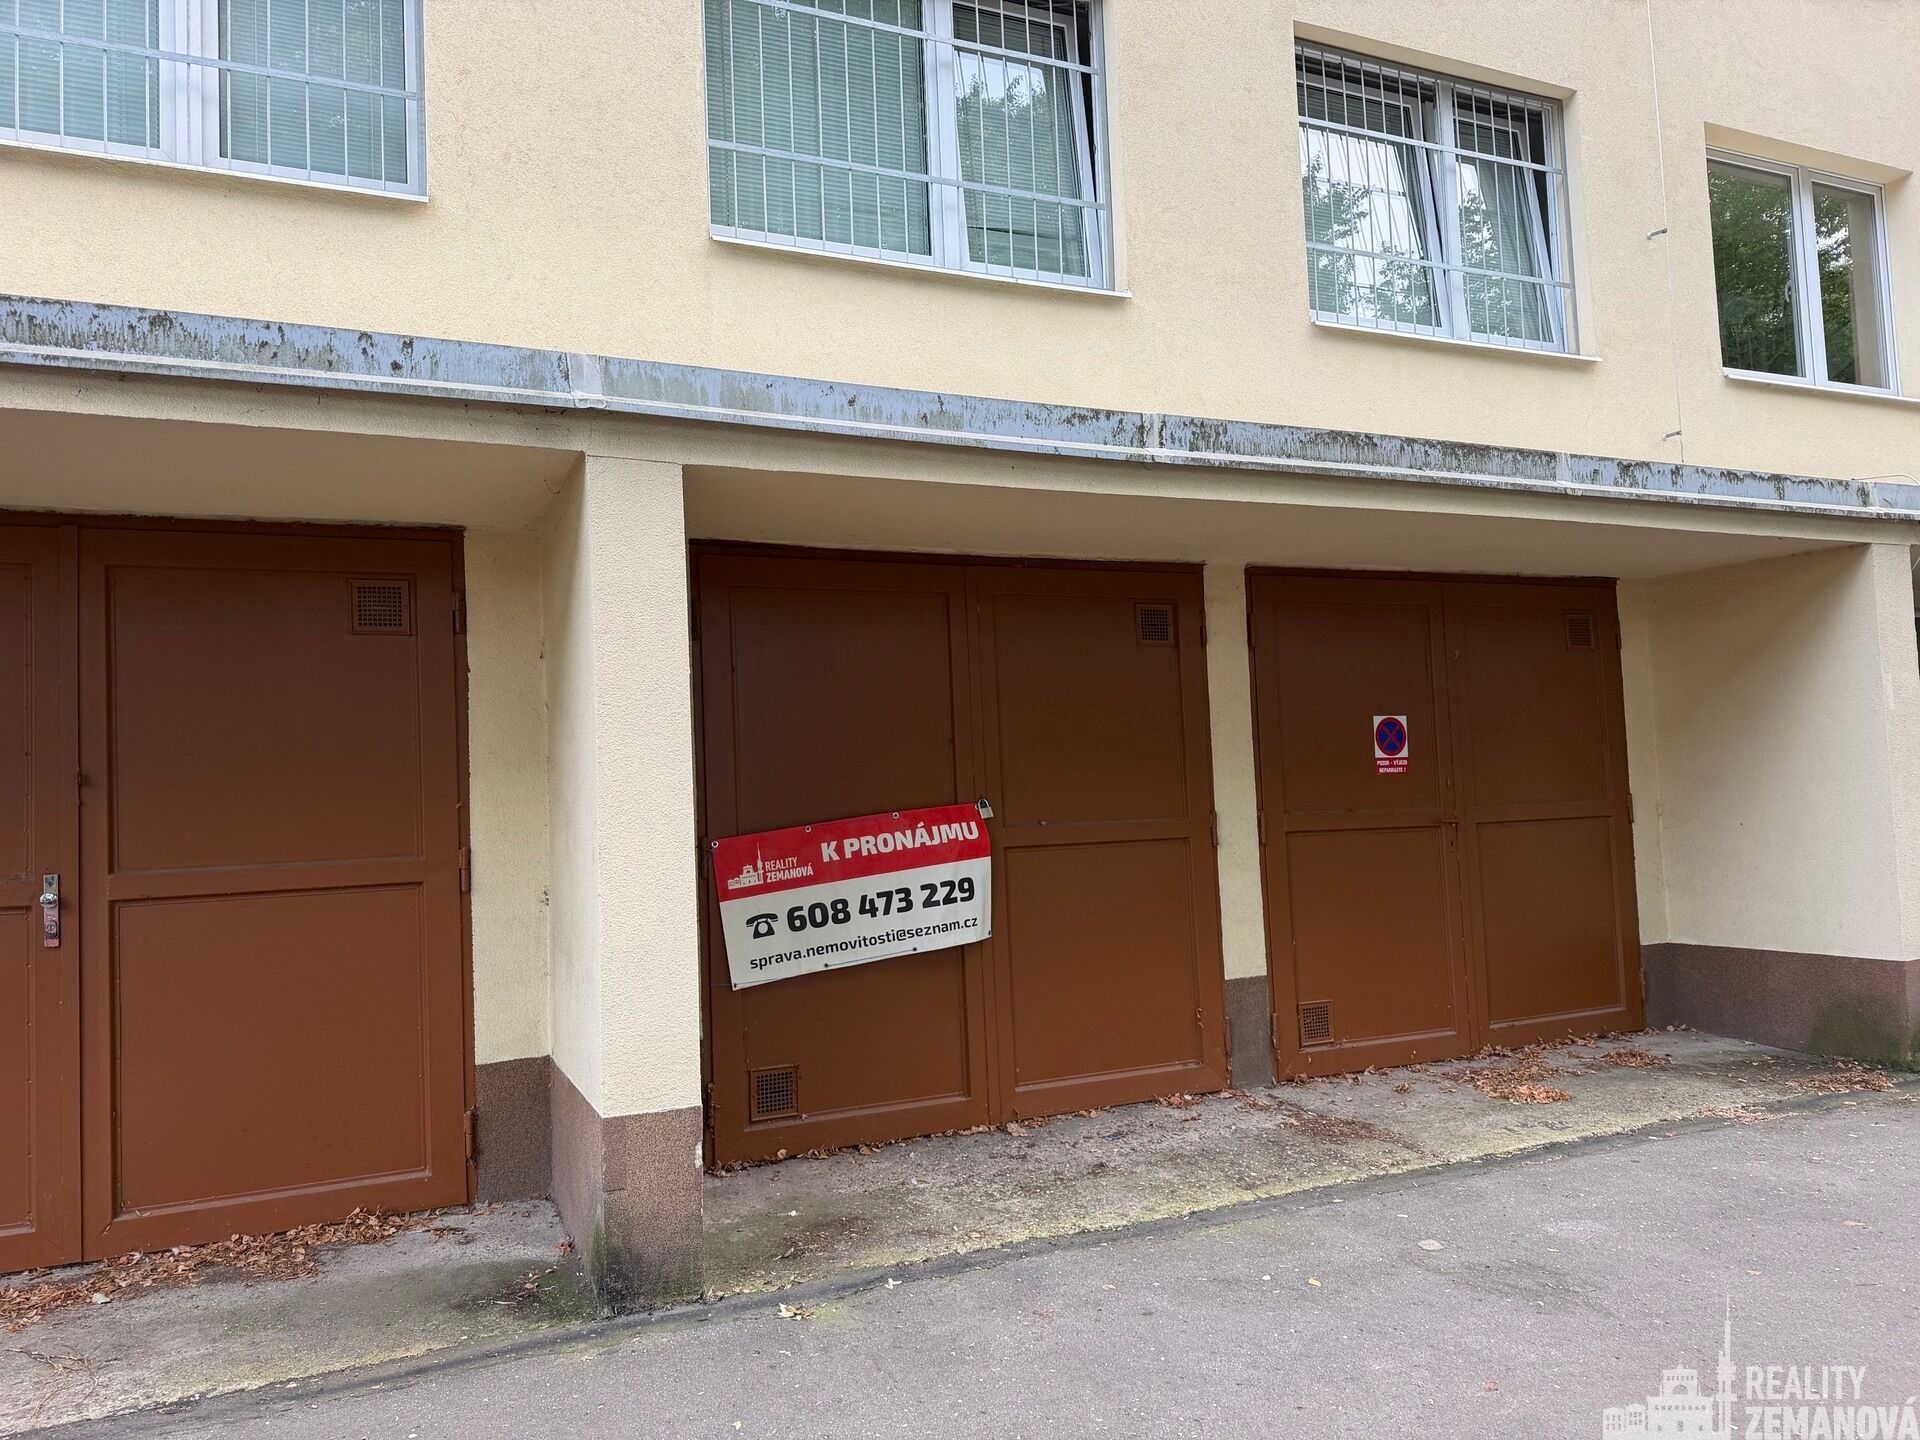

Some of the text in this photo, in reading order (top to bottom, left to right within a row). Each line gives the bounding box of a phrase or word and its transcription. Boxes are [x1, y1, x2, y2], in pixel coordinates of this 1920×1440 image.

[820, 821, 980, 863] K PRONÁJMU
[765, 856, 798, 872] REALITY
[766, 862, 814, 883] ZEMANOVÁ
[786, 877, 976, 932] 608 473 229
[749, 916, 979, 970] sprava.nemovitosti@seznam.cz
